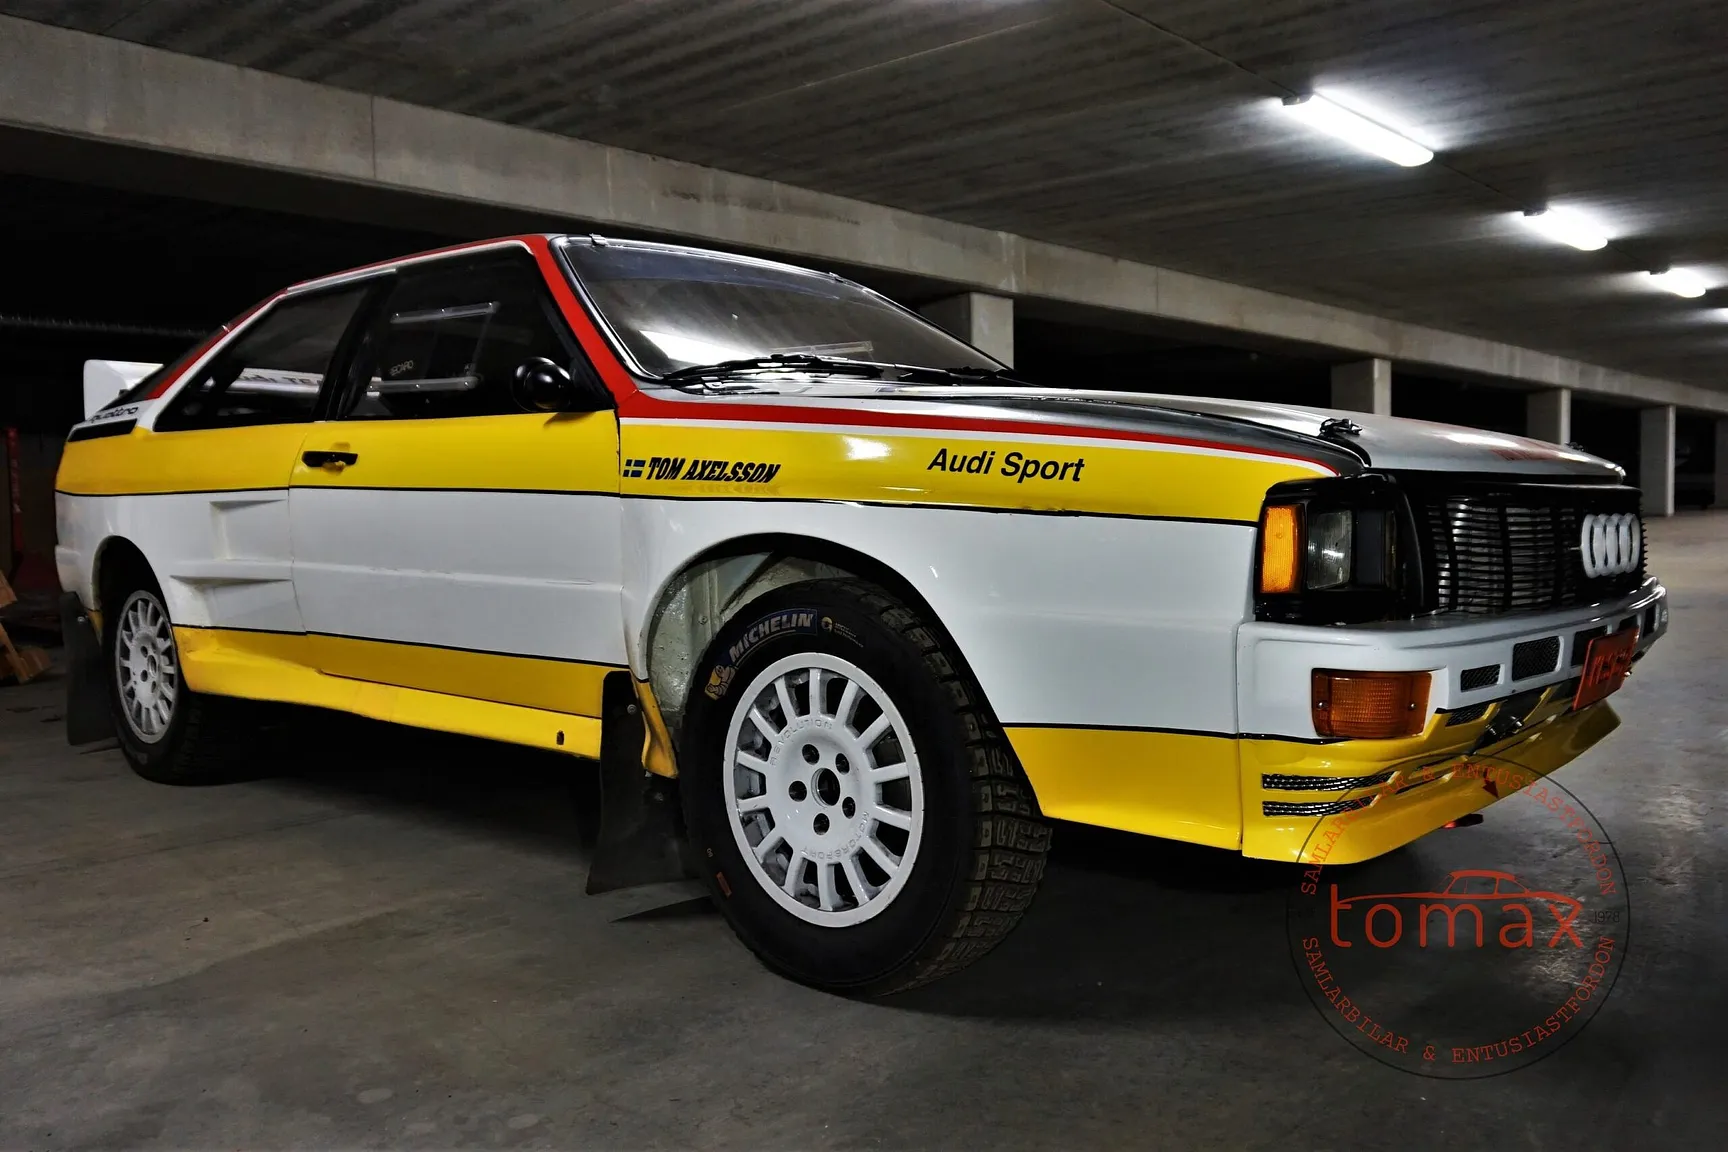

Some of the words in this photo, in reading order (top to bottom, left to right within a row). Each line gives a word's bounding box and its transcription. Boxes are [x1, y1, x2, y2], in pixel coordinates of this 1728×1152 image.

[646, 457, 686, 480] TOM
[680, 459, 781, 484] AXELSSON
[927, 448, 996, 474] Audi
[1000, 452, 1085, 484] Sport
[729, 613, 814, 662] MICHELIN
